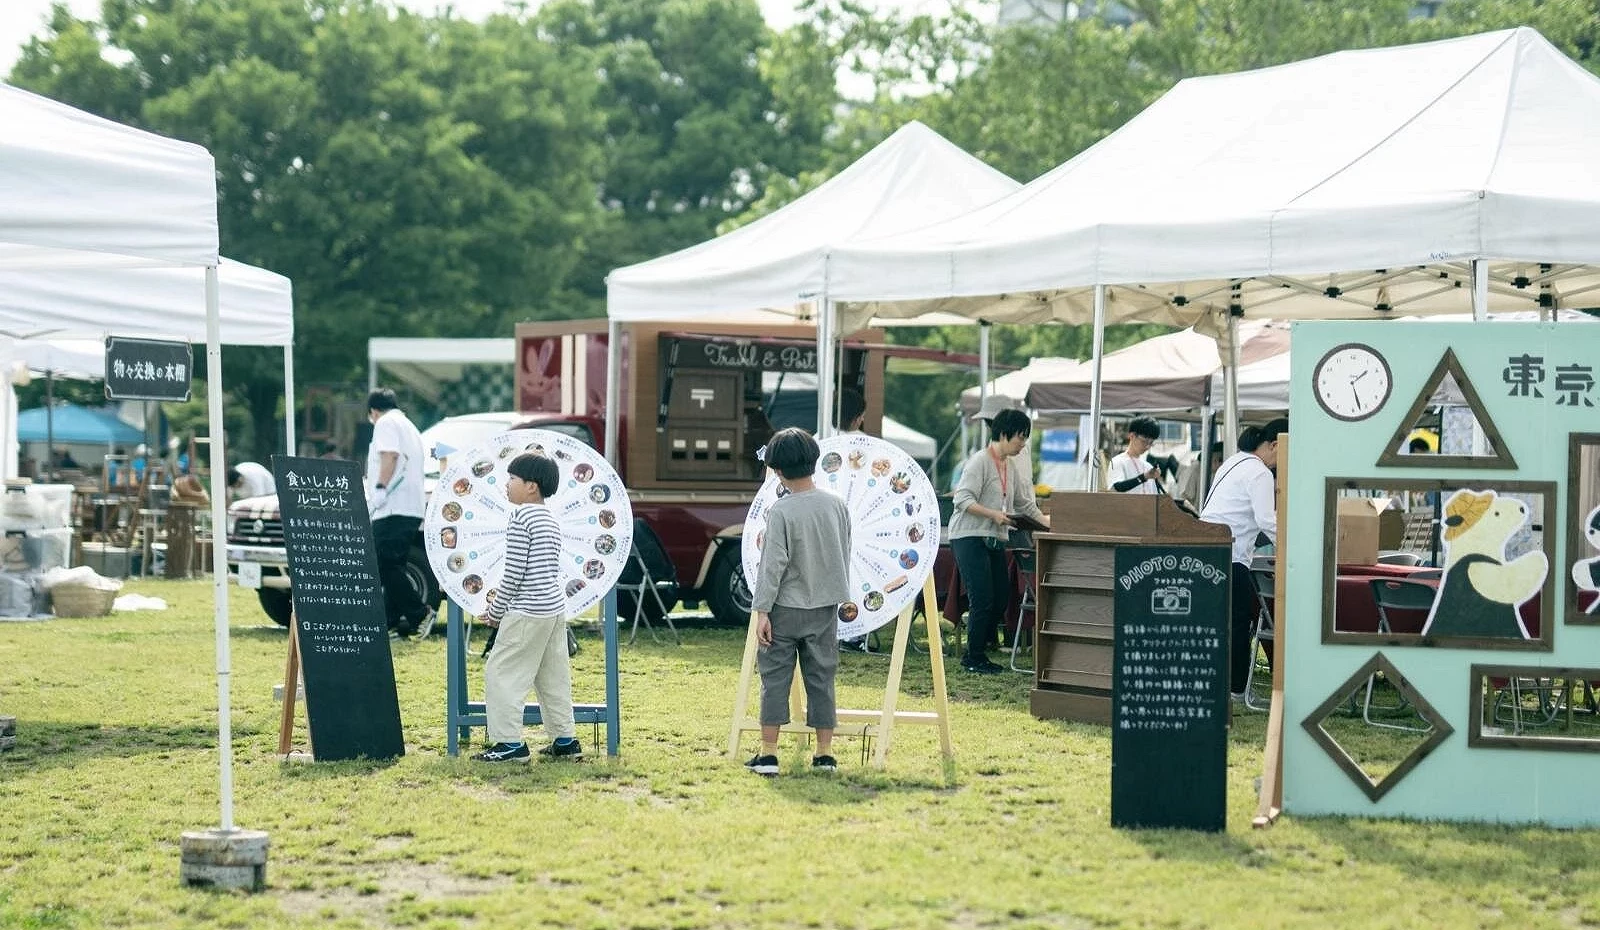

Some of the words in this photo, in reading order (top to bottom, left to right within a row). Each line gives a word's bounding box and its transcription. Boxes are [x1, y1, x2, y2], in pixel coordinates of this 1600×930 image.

[113, 358, 186, 382] 物々交換の本棚
[1502, 353, 1595, 407] 東京
[286, 470, 349, 490] 食いしん坊
[297, 493, 347, 507] ルーレット
[1119, 554, 1177, 591] PHOTO
[1179, 555, 1227, 585] SPOT
